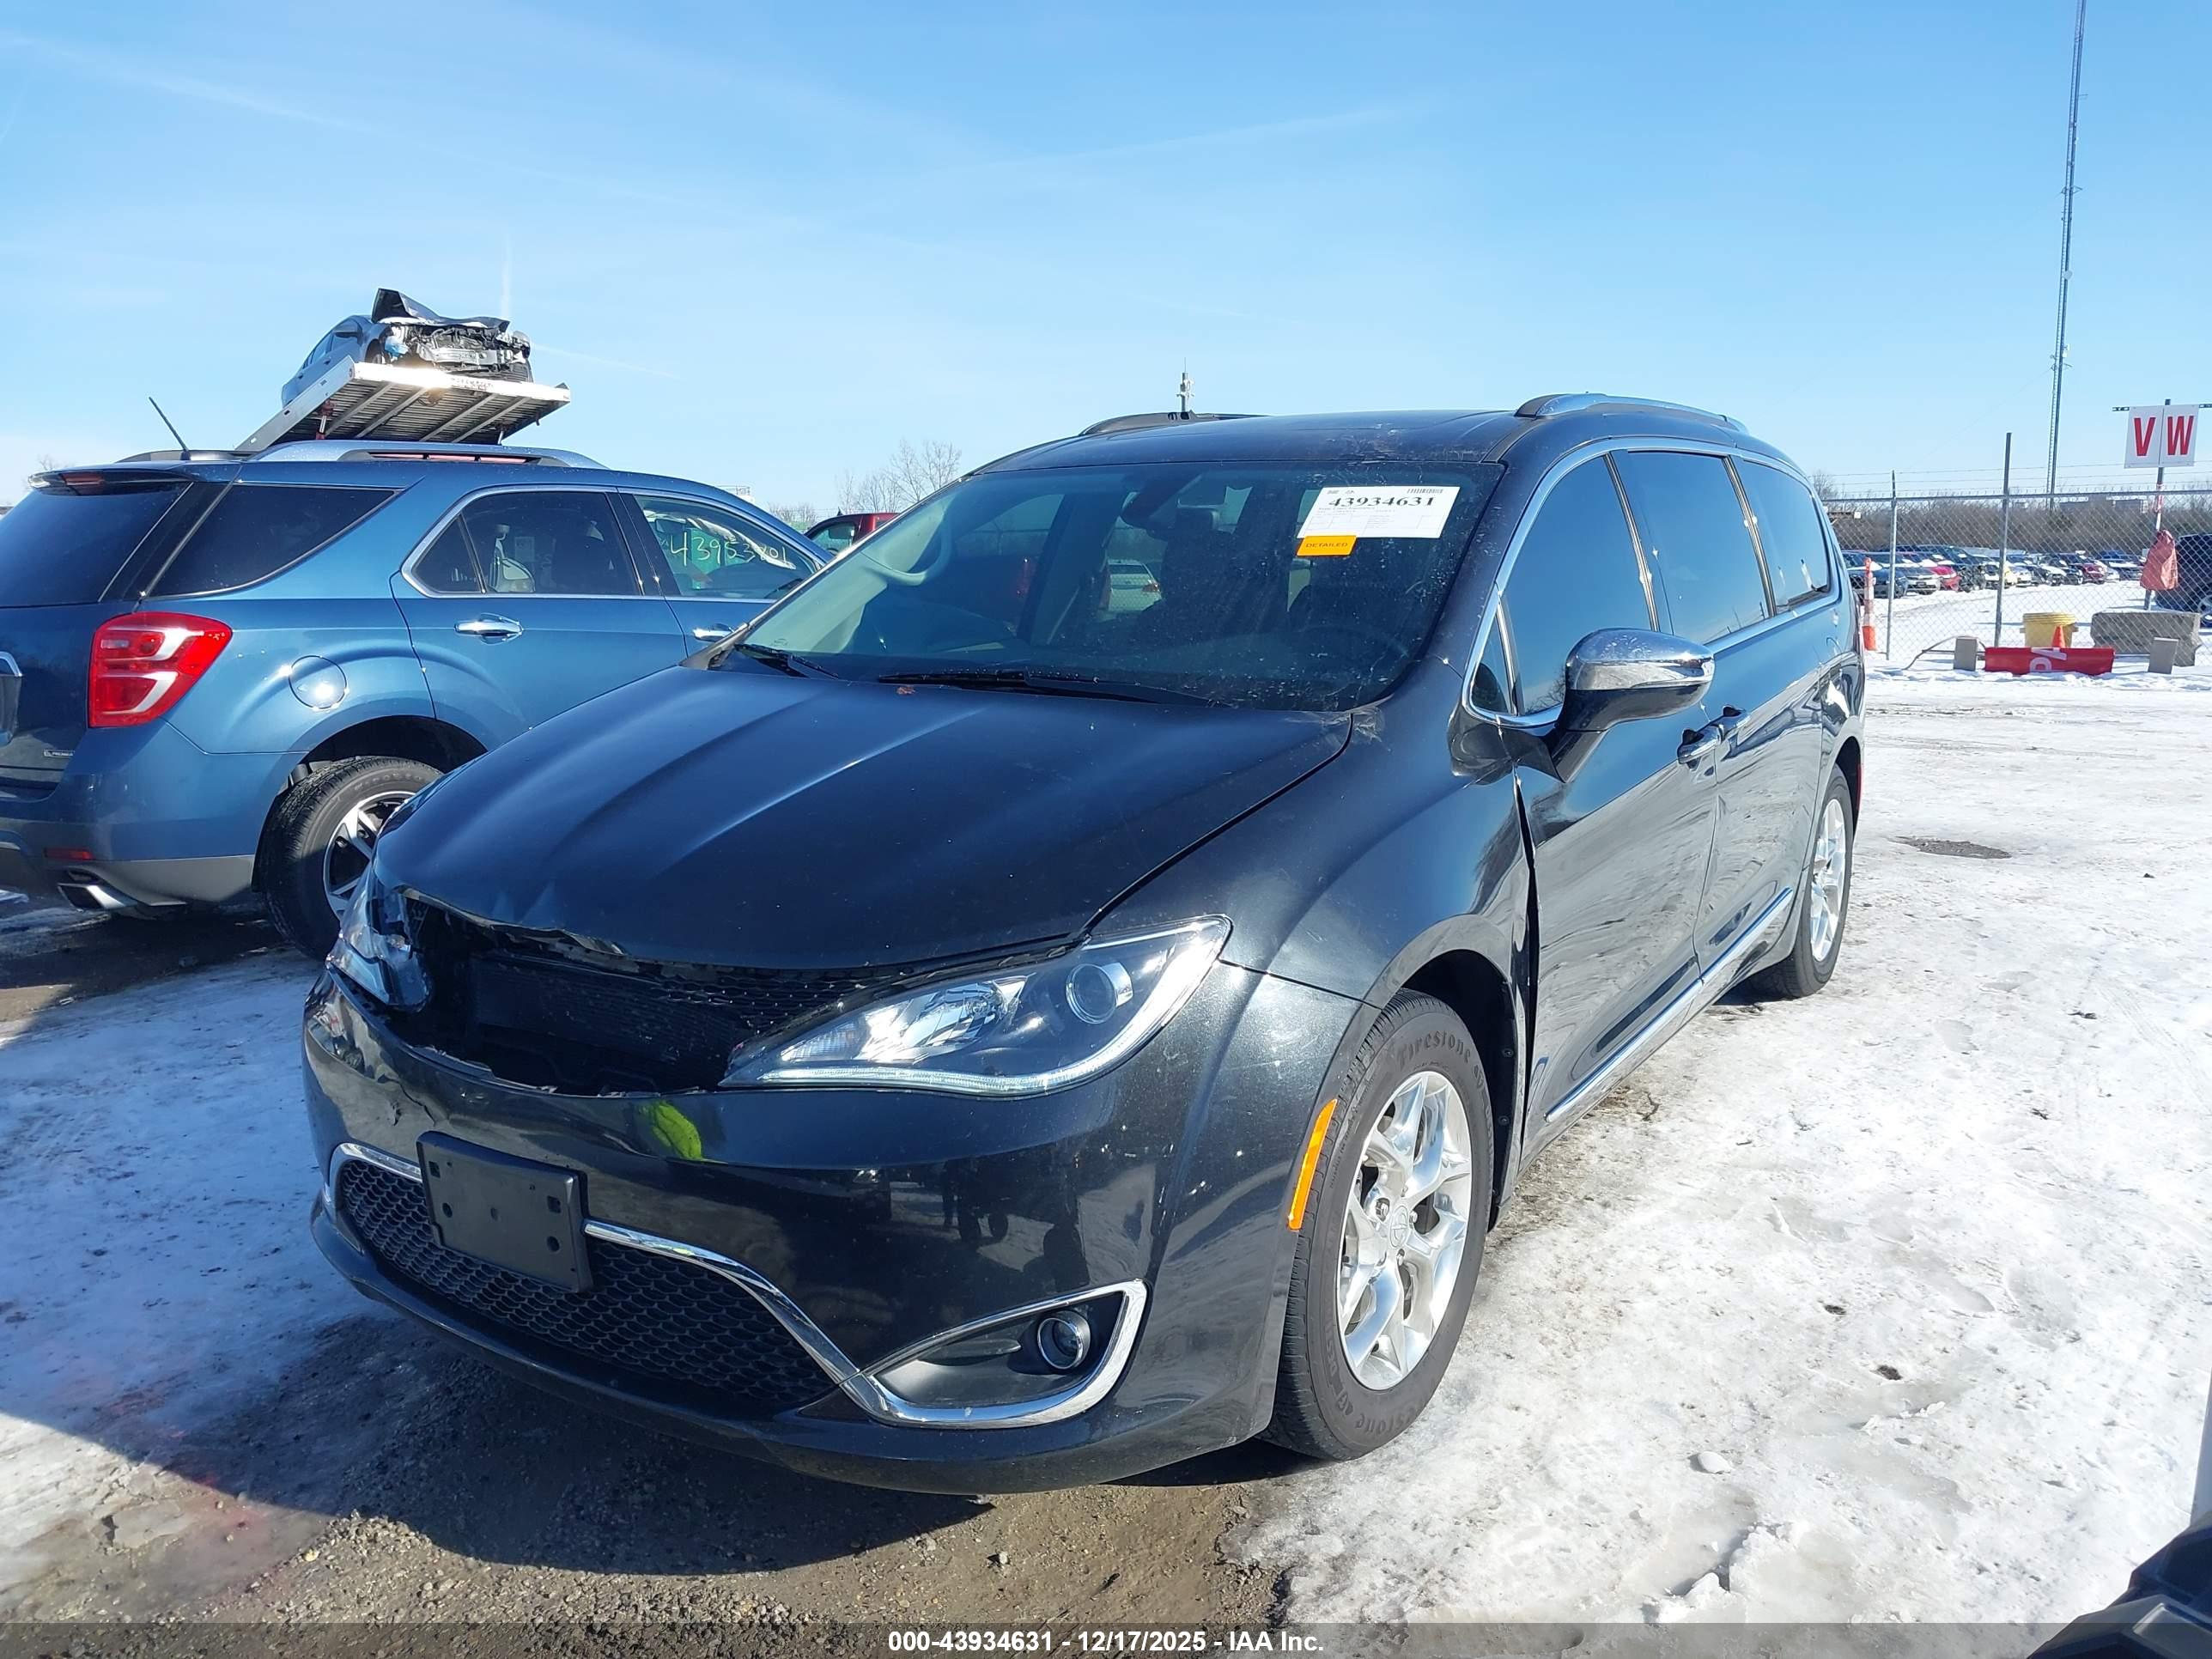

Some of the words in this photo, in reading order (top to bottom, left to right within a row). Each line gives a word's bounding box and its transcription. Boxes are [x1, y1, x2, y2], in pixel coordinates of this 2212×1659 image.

[2134, 416, 2157, 457] V
[2167, 415, 2195, 456] W
[1328, 496, 1434, 507] 43934631
